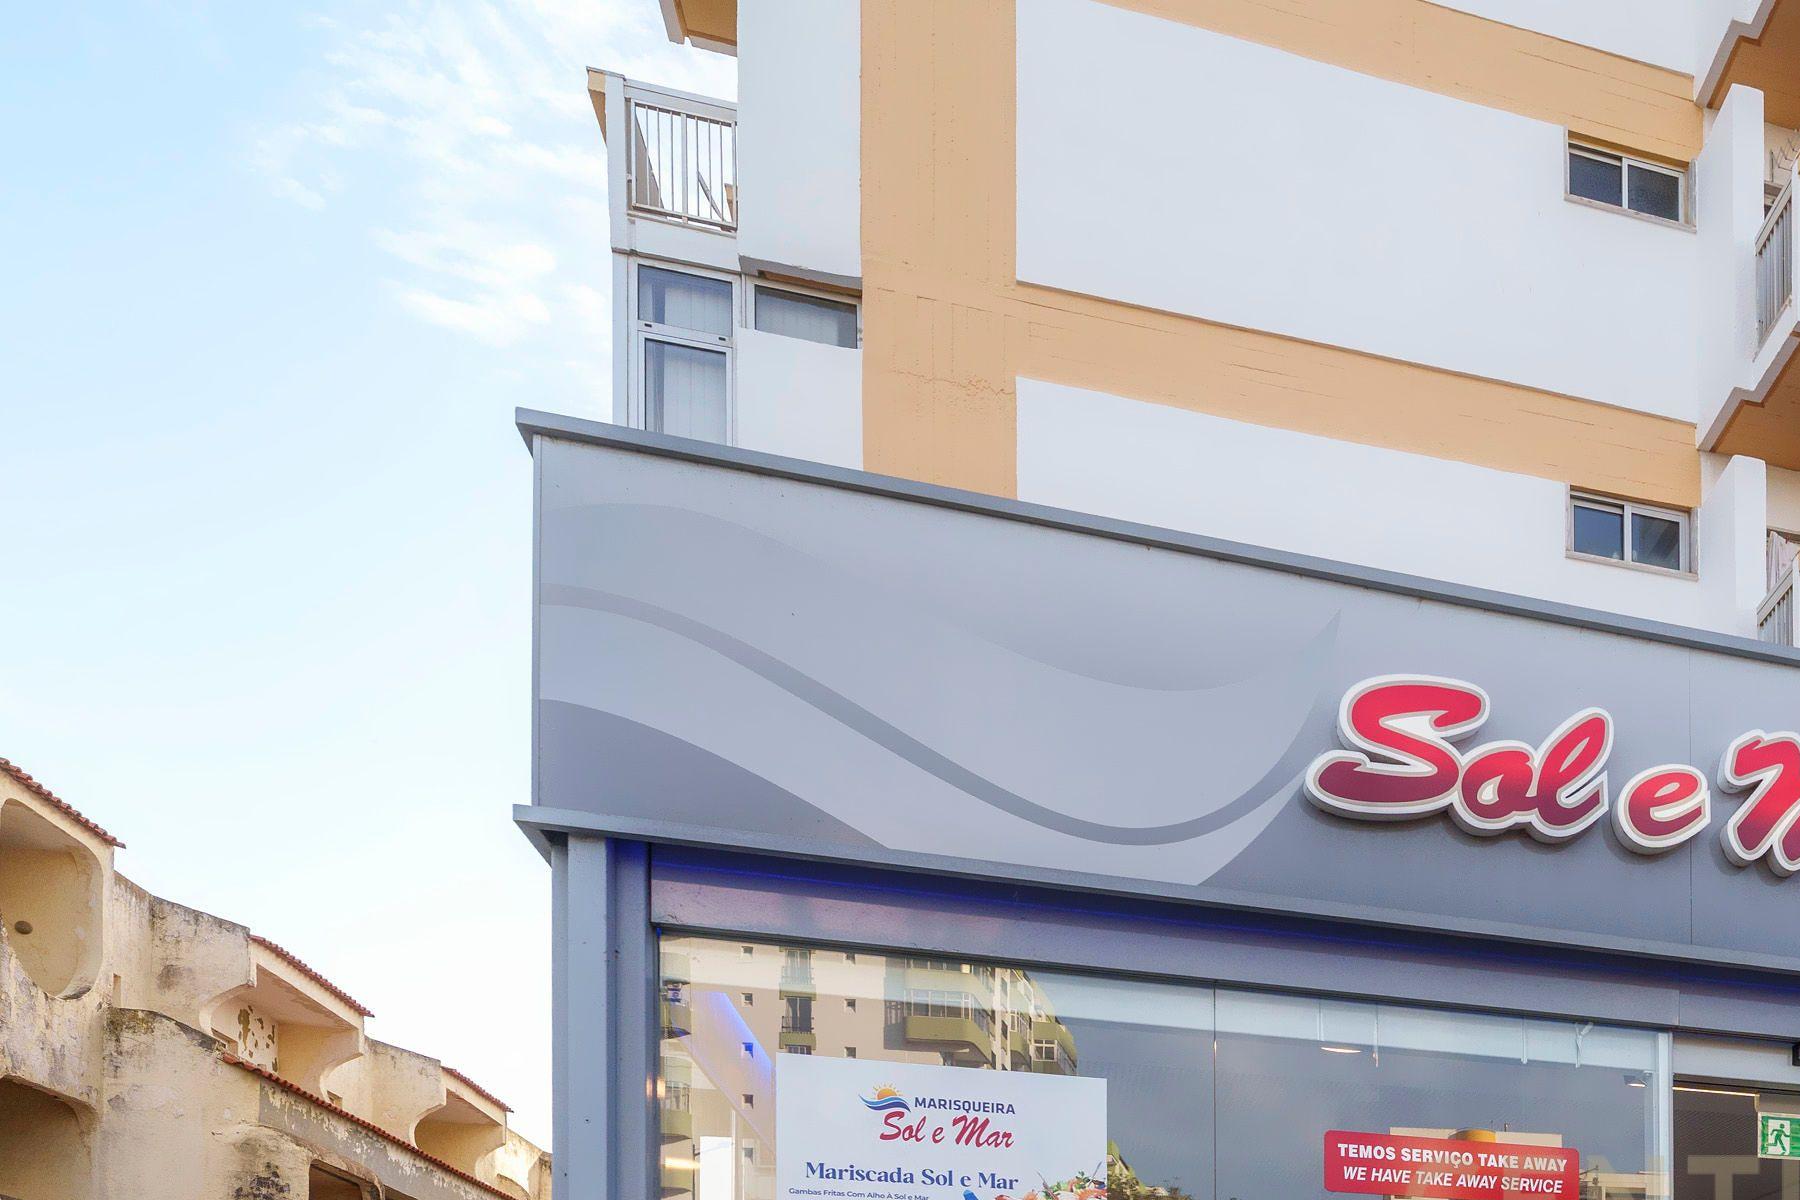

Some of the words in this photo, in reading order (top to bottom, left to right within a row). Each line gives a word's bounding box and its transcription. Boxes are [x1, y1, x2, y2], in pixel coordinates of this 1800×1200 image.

[1304, 673, 1613, 842] Sol
[1613, 763, 1710, 853] e
[914, 1096, 1016, 1115] MARISQUEIRA
[879, 1110, 926, 1144] Sol
[931, 1124, 945, 1143] e
[951, 1113, 1014, 1149] Mar
[1337, 1143, 1396, 1161] TEMOS
[1401, 1148, 1474, 1168] SERVIÇO
[1477, 1153, 1519, 1169] TAKE
[1523, 1156, 1567, 1172] AWAY
[805, 1161, 915, 1185] Mariscada
[920, 1168, 953, 1187] Sol
[960, 1175, 972, 1188] e
[977, 1171, 1019, 1190] Mar
[1343, 1165, 1366, 1181] WE
[1370, 1168, 1411, 1184] HAVE
[1415, 1171, 1453, 1187] TAKE
[1456, 1174, 1498, 1189] AWAY
[1501, 1176, 1564, 1194] SERVICE
[788, 1187, 822, 1197] Gambas
[823, 1189, 845, 1197] Fritas
[847, 1190, 865, 1198] Com
[867, 1191, 885, 1199] Alho
